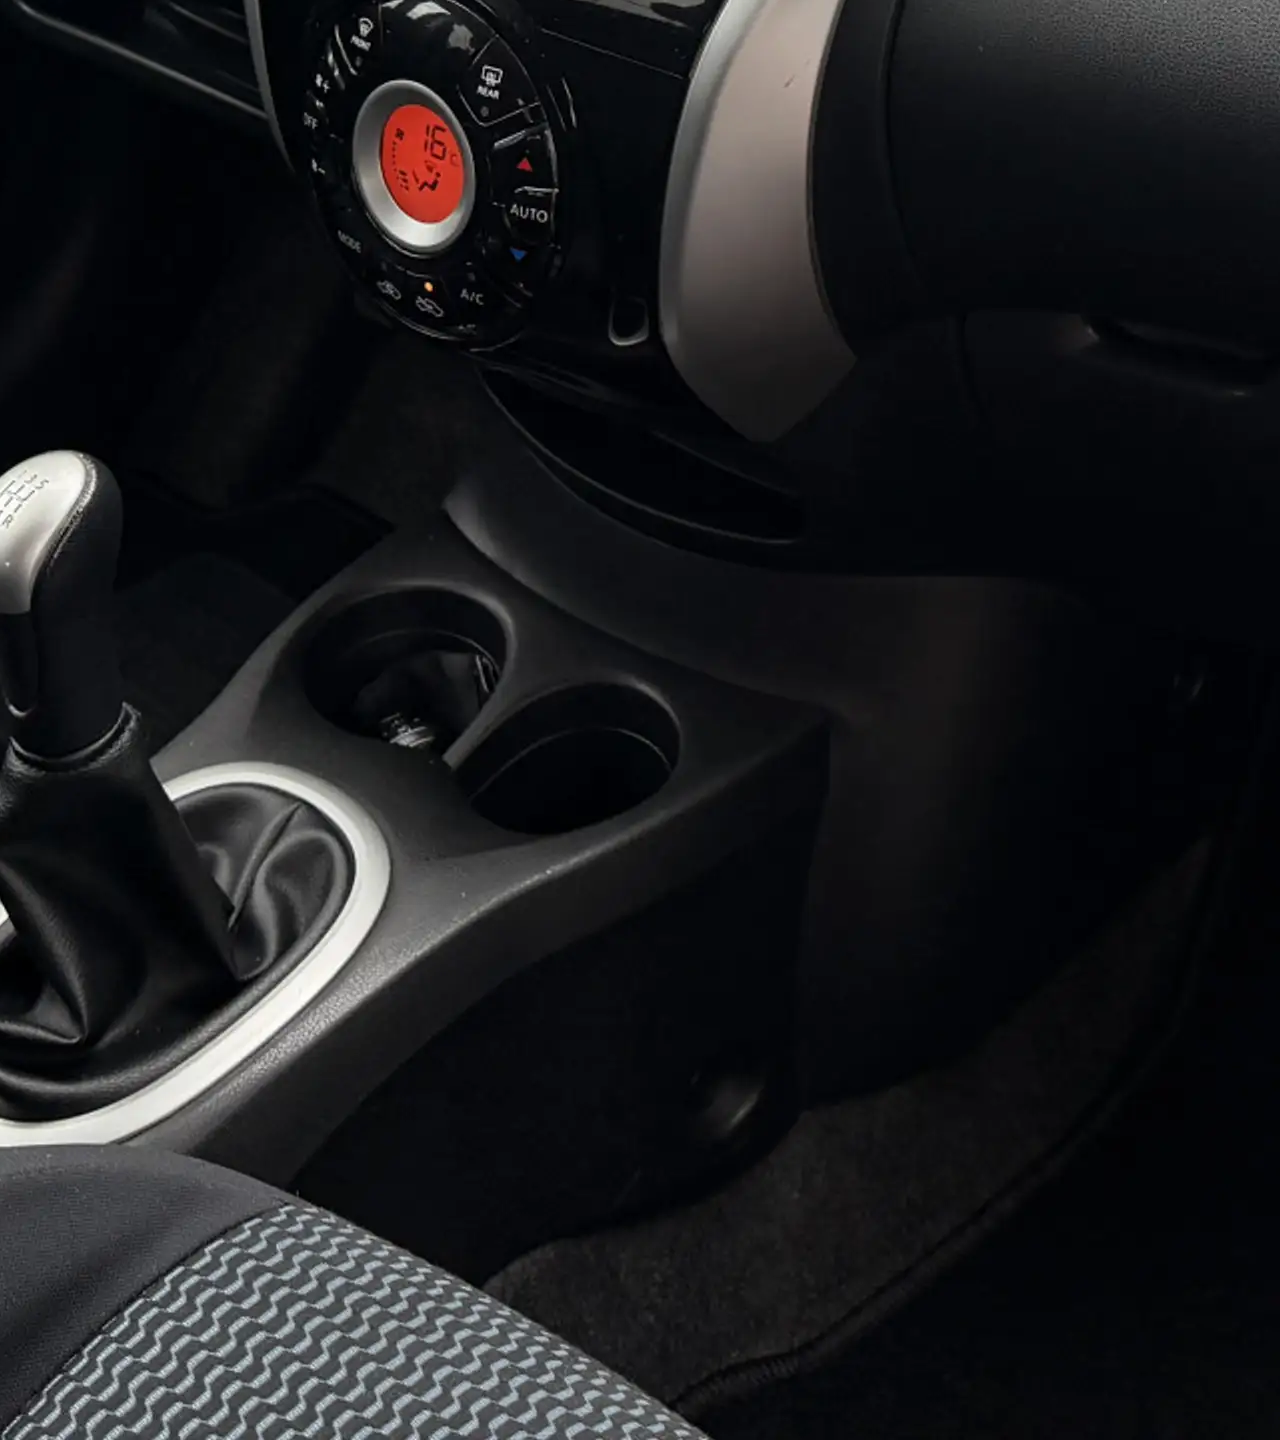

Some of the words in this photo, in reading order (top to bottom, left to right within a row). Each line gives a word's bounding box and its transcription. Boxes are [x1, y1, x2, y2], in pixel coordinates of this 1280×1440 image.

[476, 85, 500, 100] REAR
[510, 202, 549, 224] AUTO
[460, 287, 485, 306] A/C
